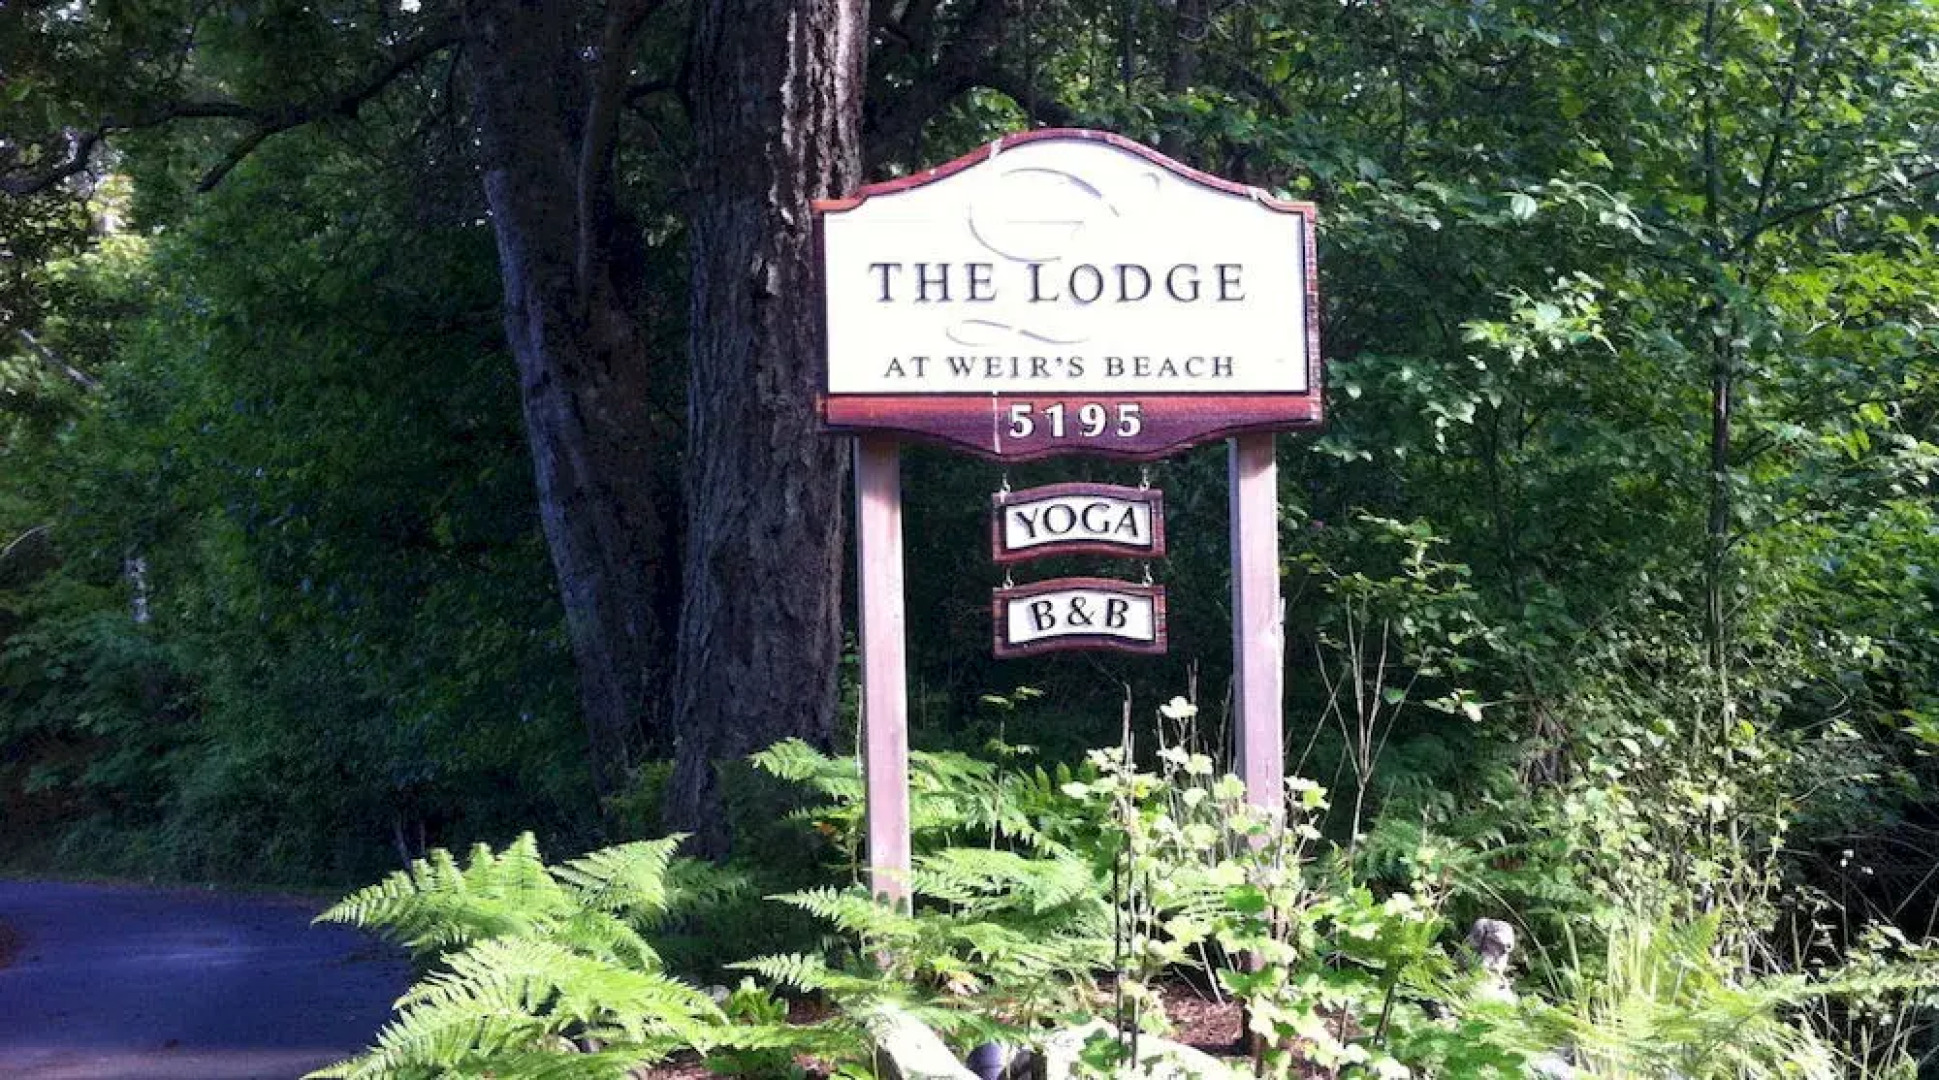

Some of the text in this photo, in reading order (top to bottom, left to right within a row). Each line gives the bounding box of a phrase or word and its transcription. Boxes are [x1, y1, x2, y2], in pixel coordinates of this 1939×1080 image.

[868, 262, 1247, 305] THE LODGE
[884, 356, 1235, 378] AT WEIR'S BEACH
[1008, 402, 1142, 438] 5195
[1015, 502, 1140, 538] YOGA
